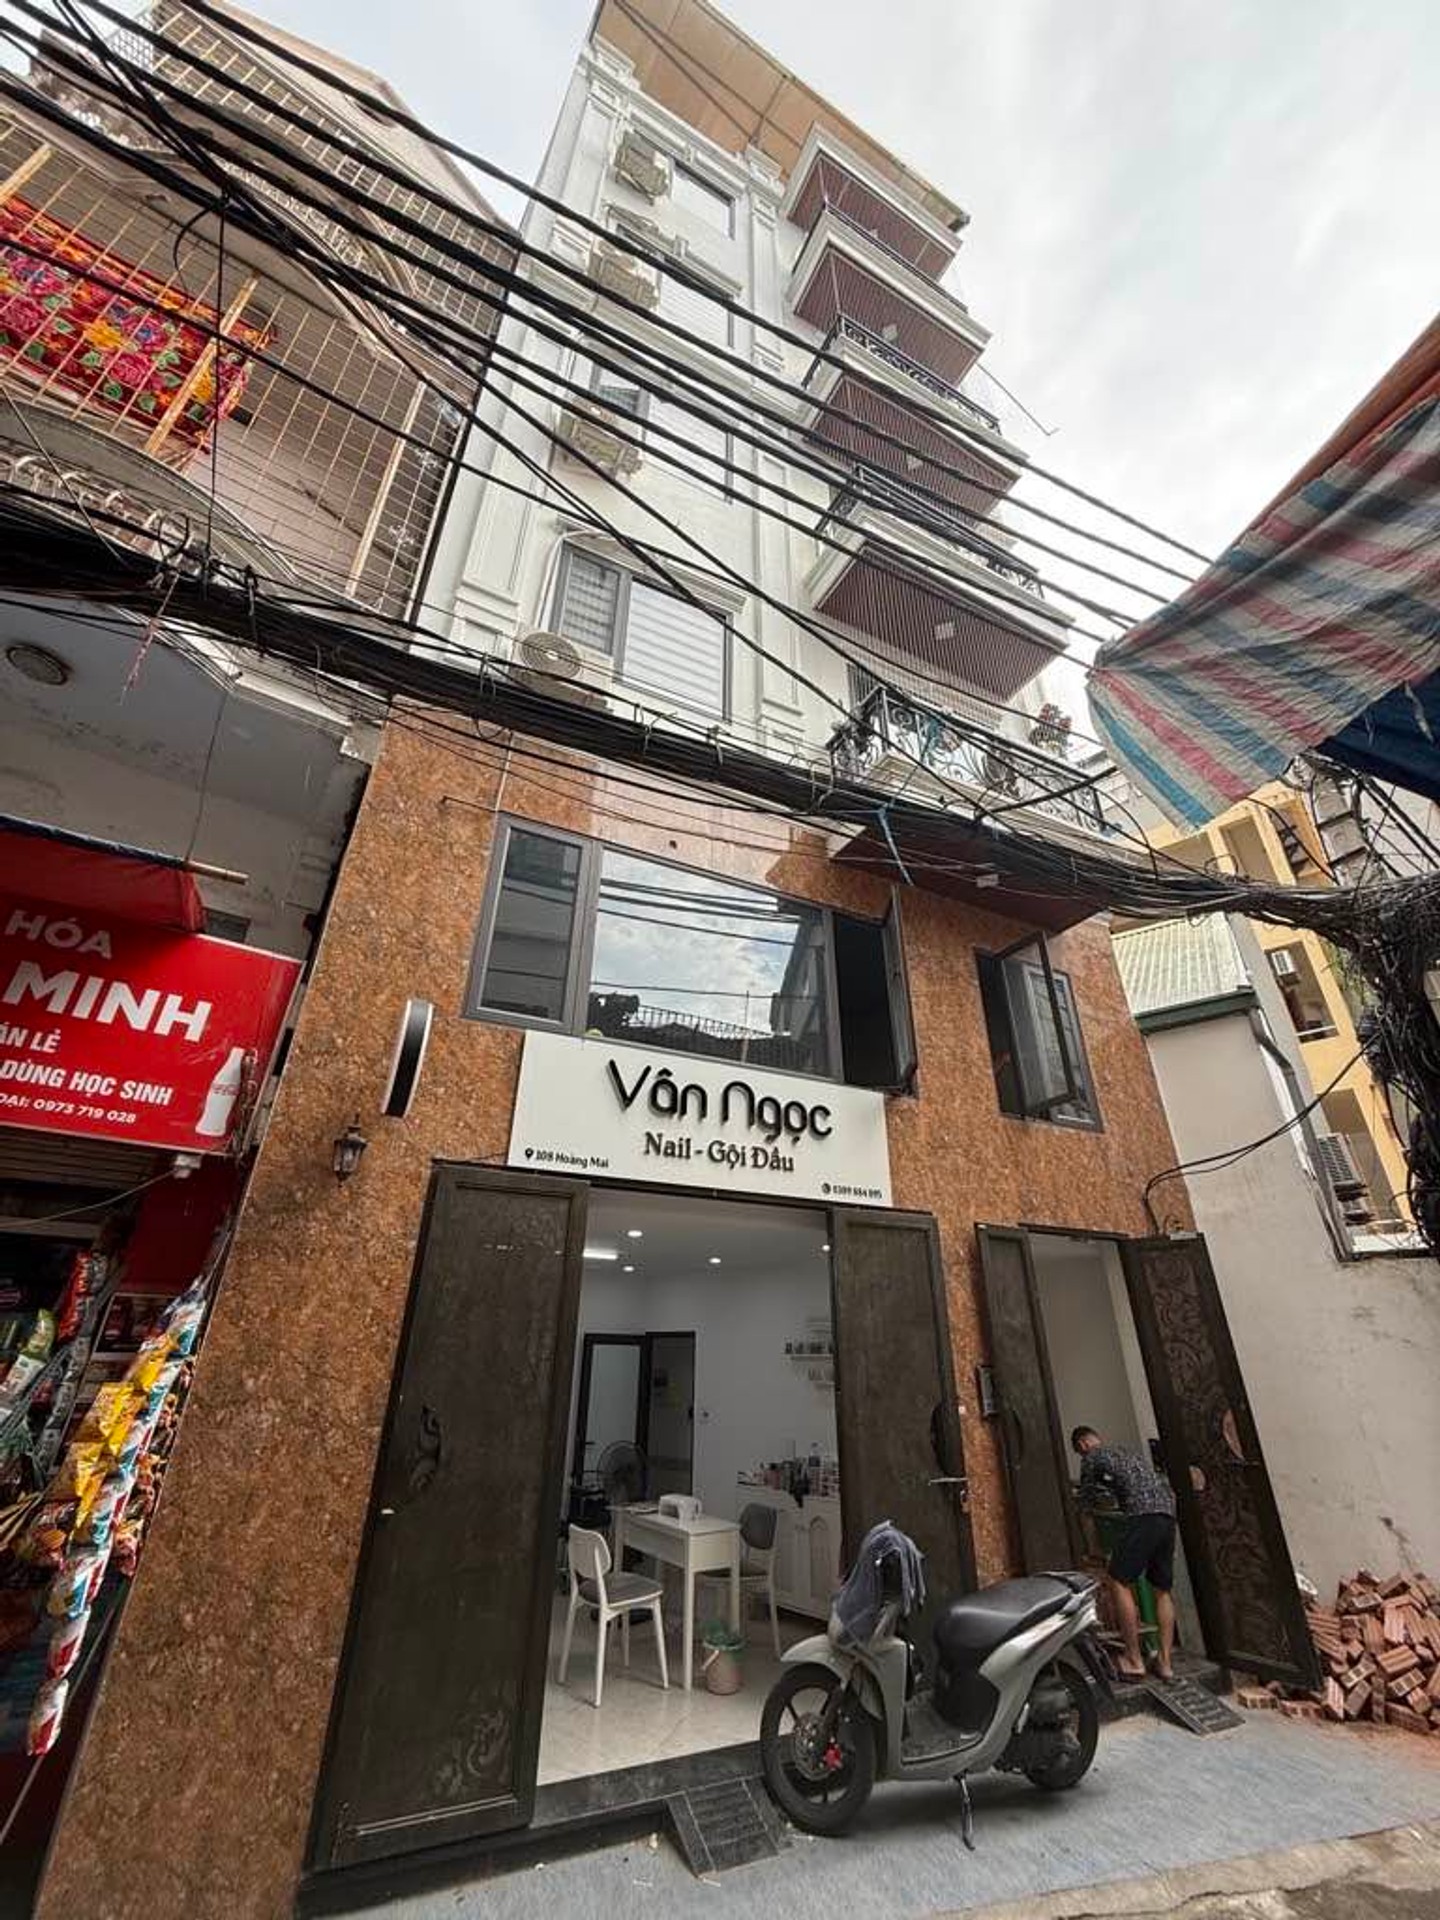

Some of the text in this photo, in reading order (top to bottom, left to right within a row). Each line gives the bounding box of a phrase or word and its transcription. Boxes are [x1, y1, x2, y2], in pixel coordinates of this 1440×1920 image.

[5, 909, 112, 959] HÓA
[2, 960, 212, 1043] MINH
[30, 1028, 61, 1053] LẺ
[0, 1059, 174, 1106] DÙNG HỌC SINH
[607, 1059, 833, 1148] Vân Ngọc
[33, 1098, 75, 1114] 0973
[77, 1106, 104, 1119] 719
[107, 1110, 137, 1124] 028
[589, 1156, 609, 1168] Mai
[644, 1132, 691, 1160] Nail
[707, 1140, 746, 1173] Gội
[751, 1146, 795, 1173] Đầu
